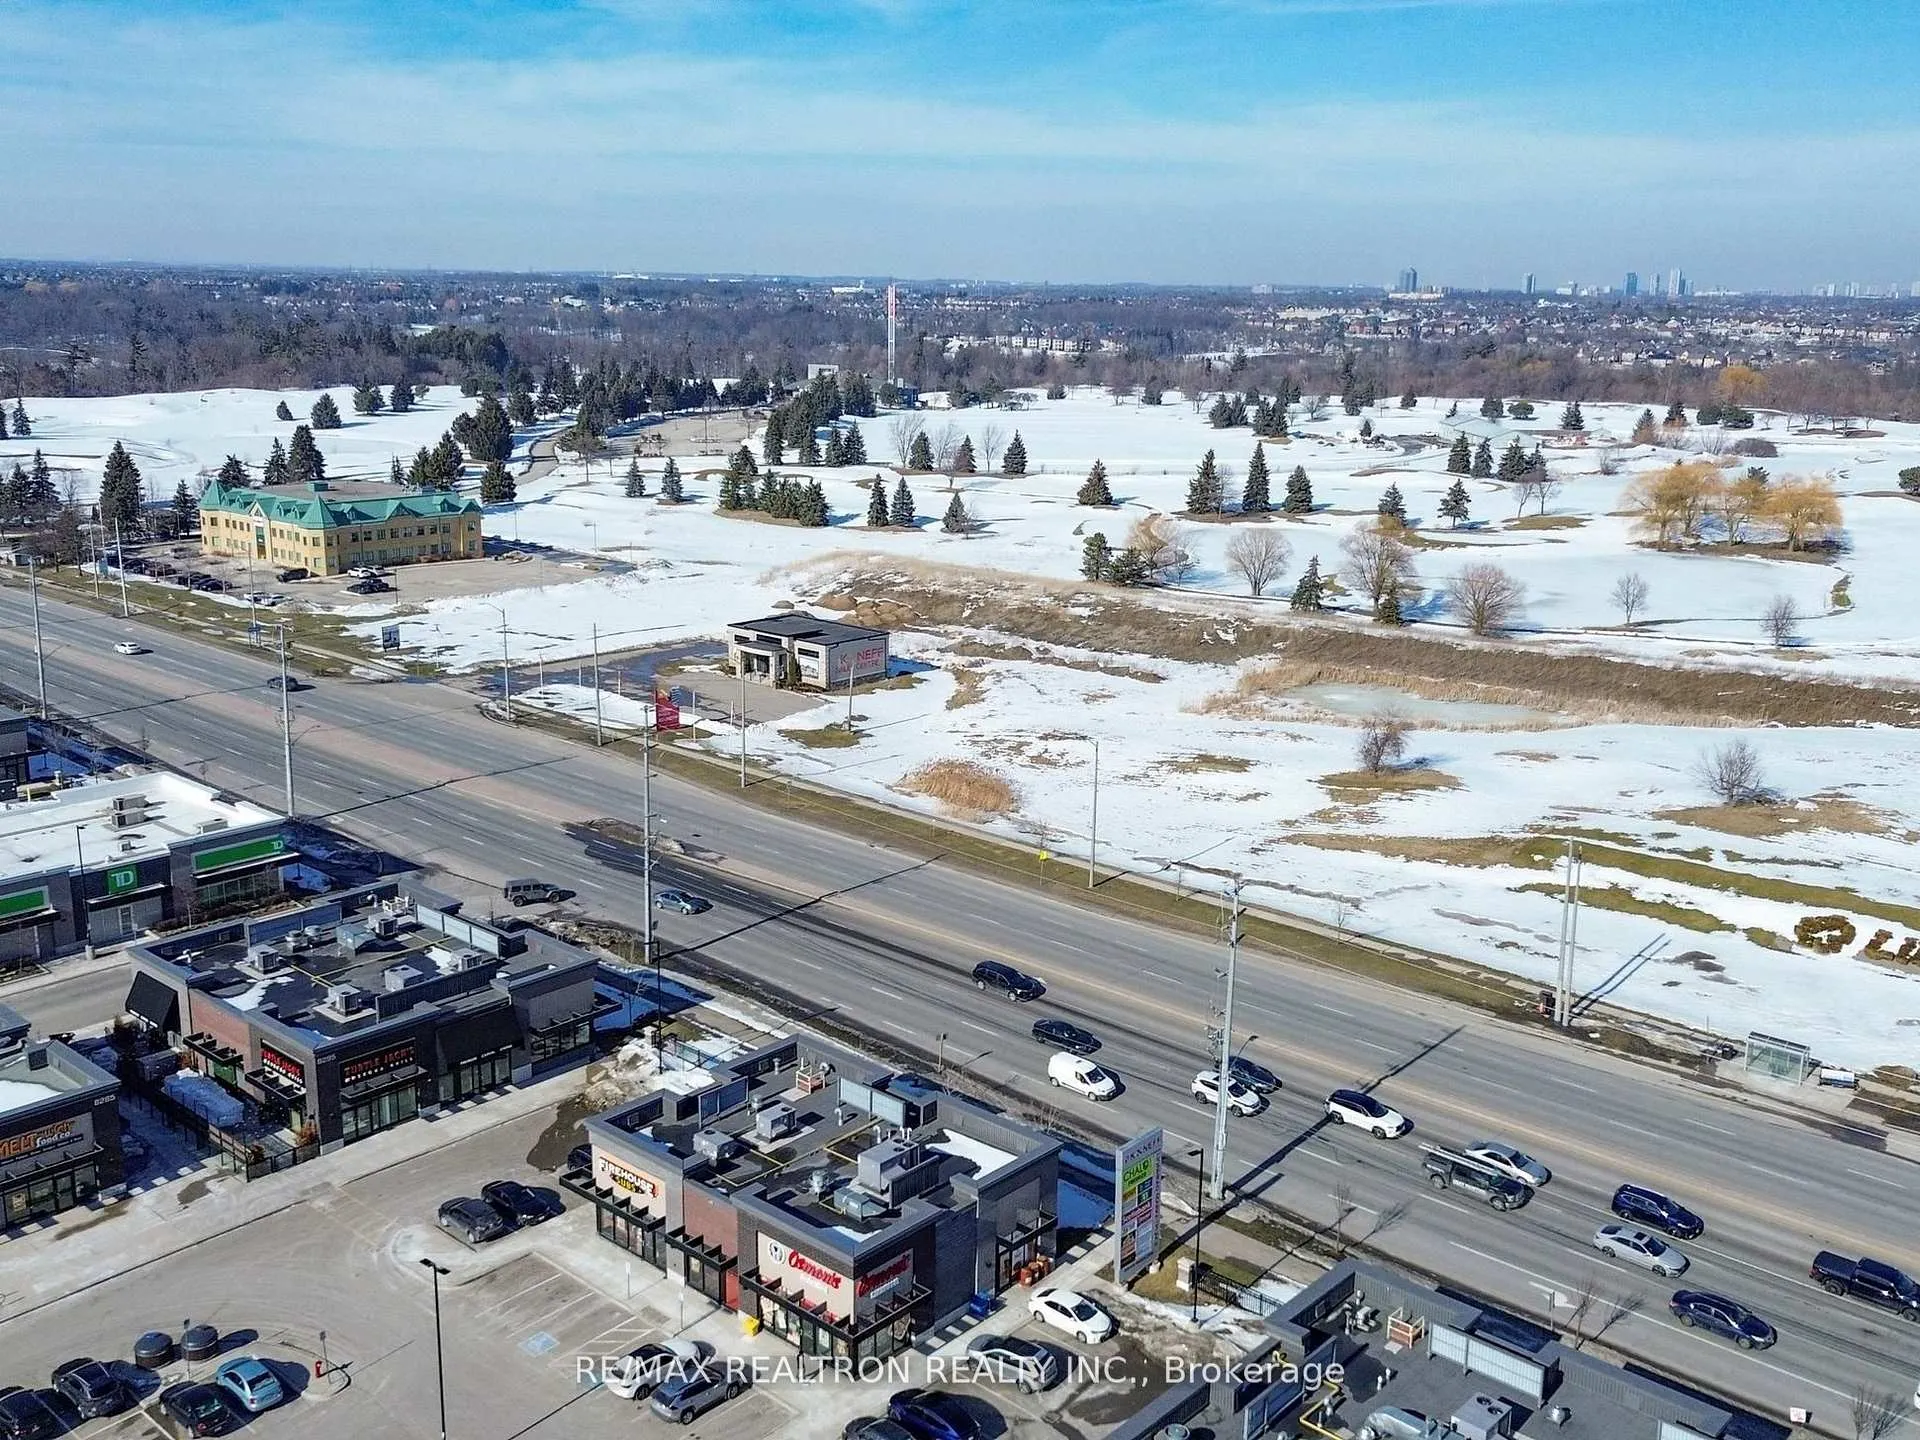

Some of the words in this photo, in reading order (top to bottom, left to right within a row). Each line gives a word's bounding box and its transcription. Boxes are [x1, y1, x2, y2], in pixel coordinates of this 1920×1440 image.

[270, 840, 284, 850] TD
[111, 870, 134, 888] TD
[36, 1133, 59, 1149] food
[599, 1157, 656, 1198] FIREHOUSE
